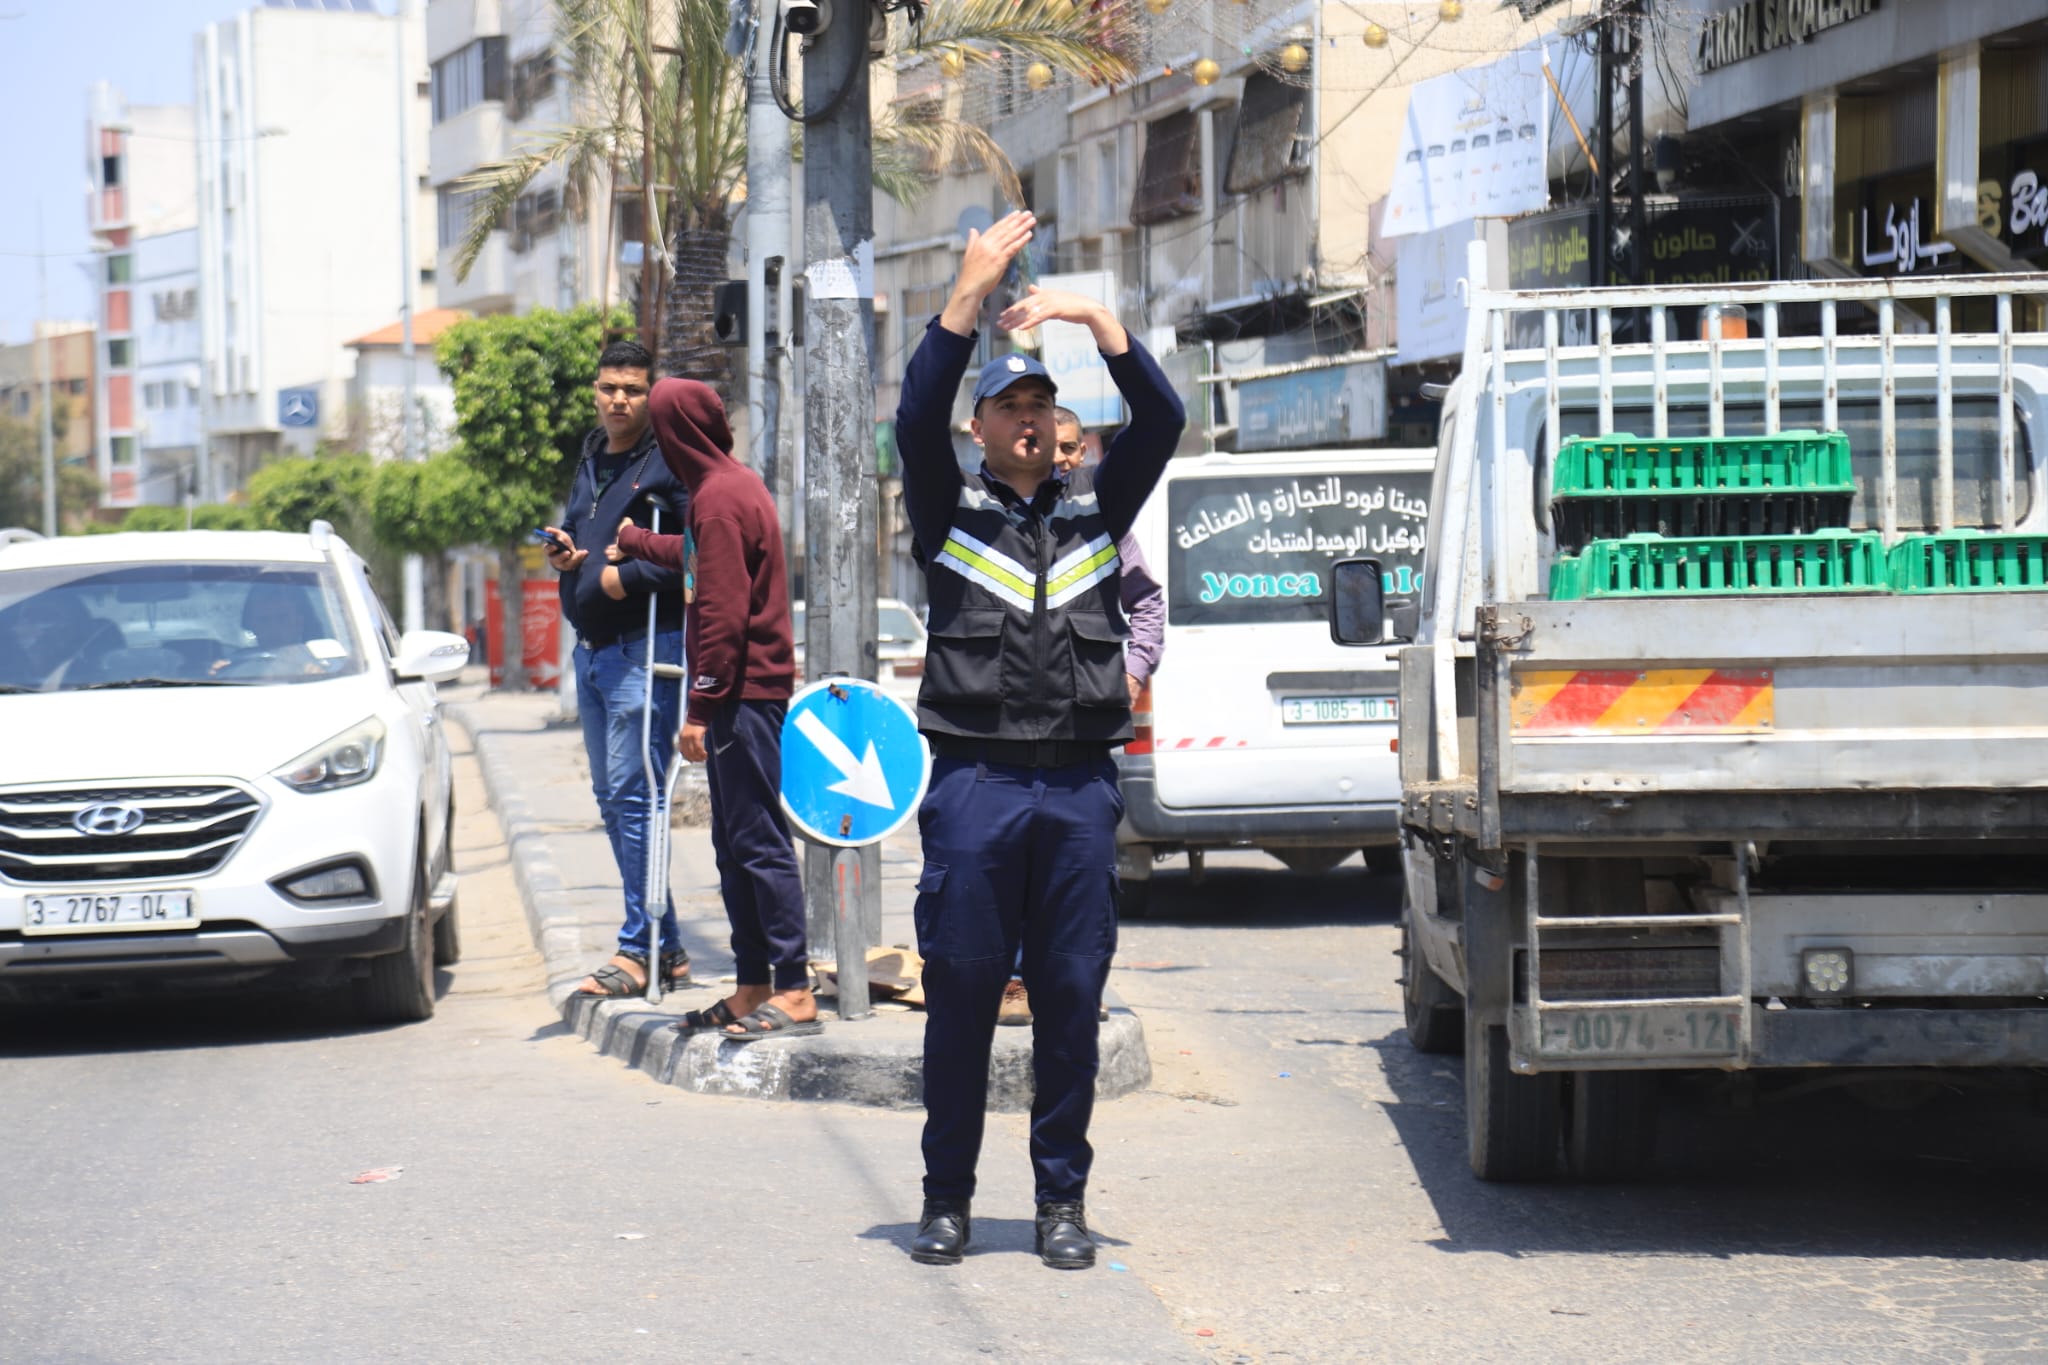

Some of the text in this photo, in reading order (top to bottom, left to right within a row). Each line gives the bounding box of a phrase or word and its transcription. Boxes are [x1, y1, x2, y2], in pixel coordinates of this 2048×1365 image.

[1763, 0, 1871, 50] SAQAL
[2010, 171, 2048, 247] Ba
[1558, 226, 1589, 274] صالون
[1653, 226, 1716, 260] صالون
[1862, 197, 1956, 272] بازوكا
[1259, 500, 1274, 522] و
[1273, 476, 1341, 517] للتجارة
[1345, 486, 1385, 516] فود
[1176, 492, 1256, 550] الصناعة
[1248, 524, 1426, 558] لوكيل الوحيد لمنتجات
[1200, 570, 1322, 604] yonca
